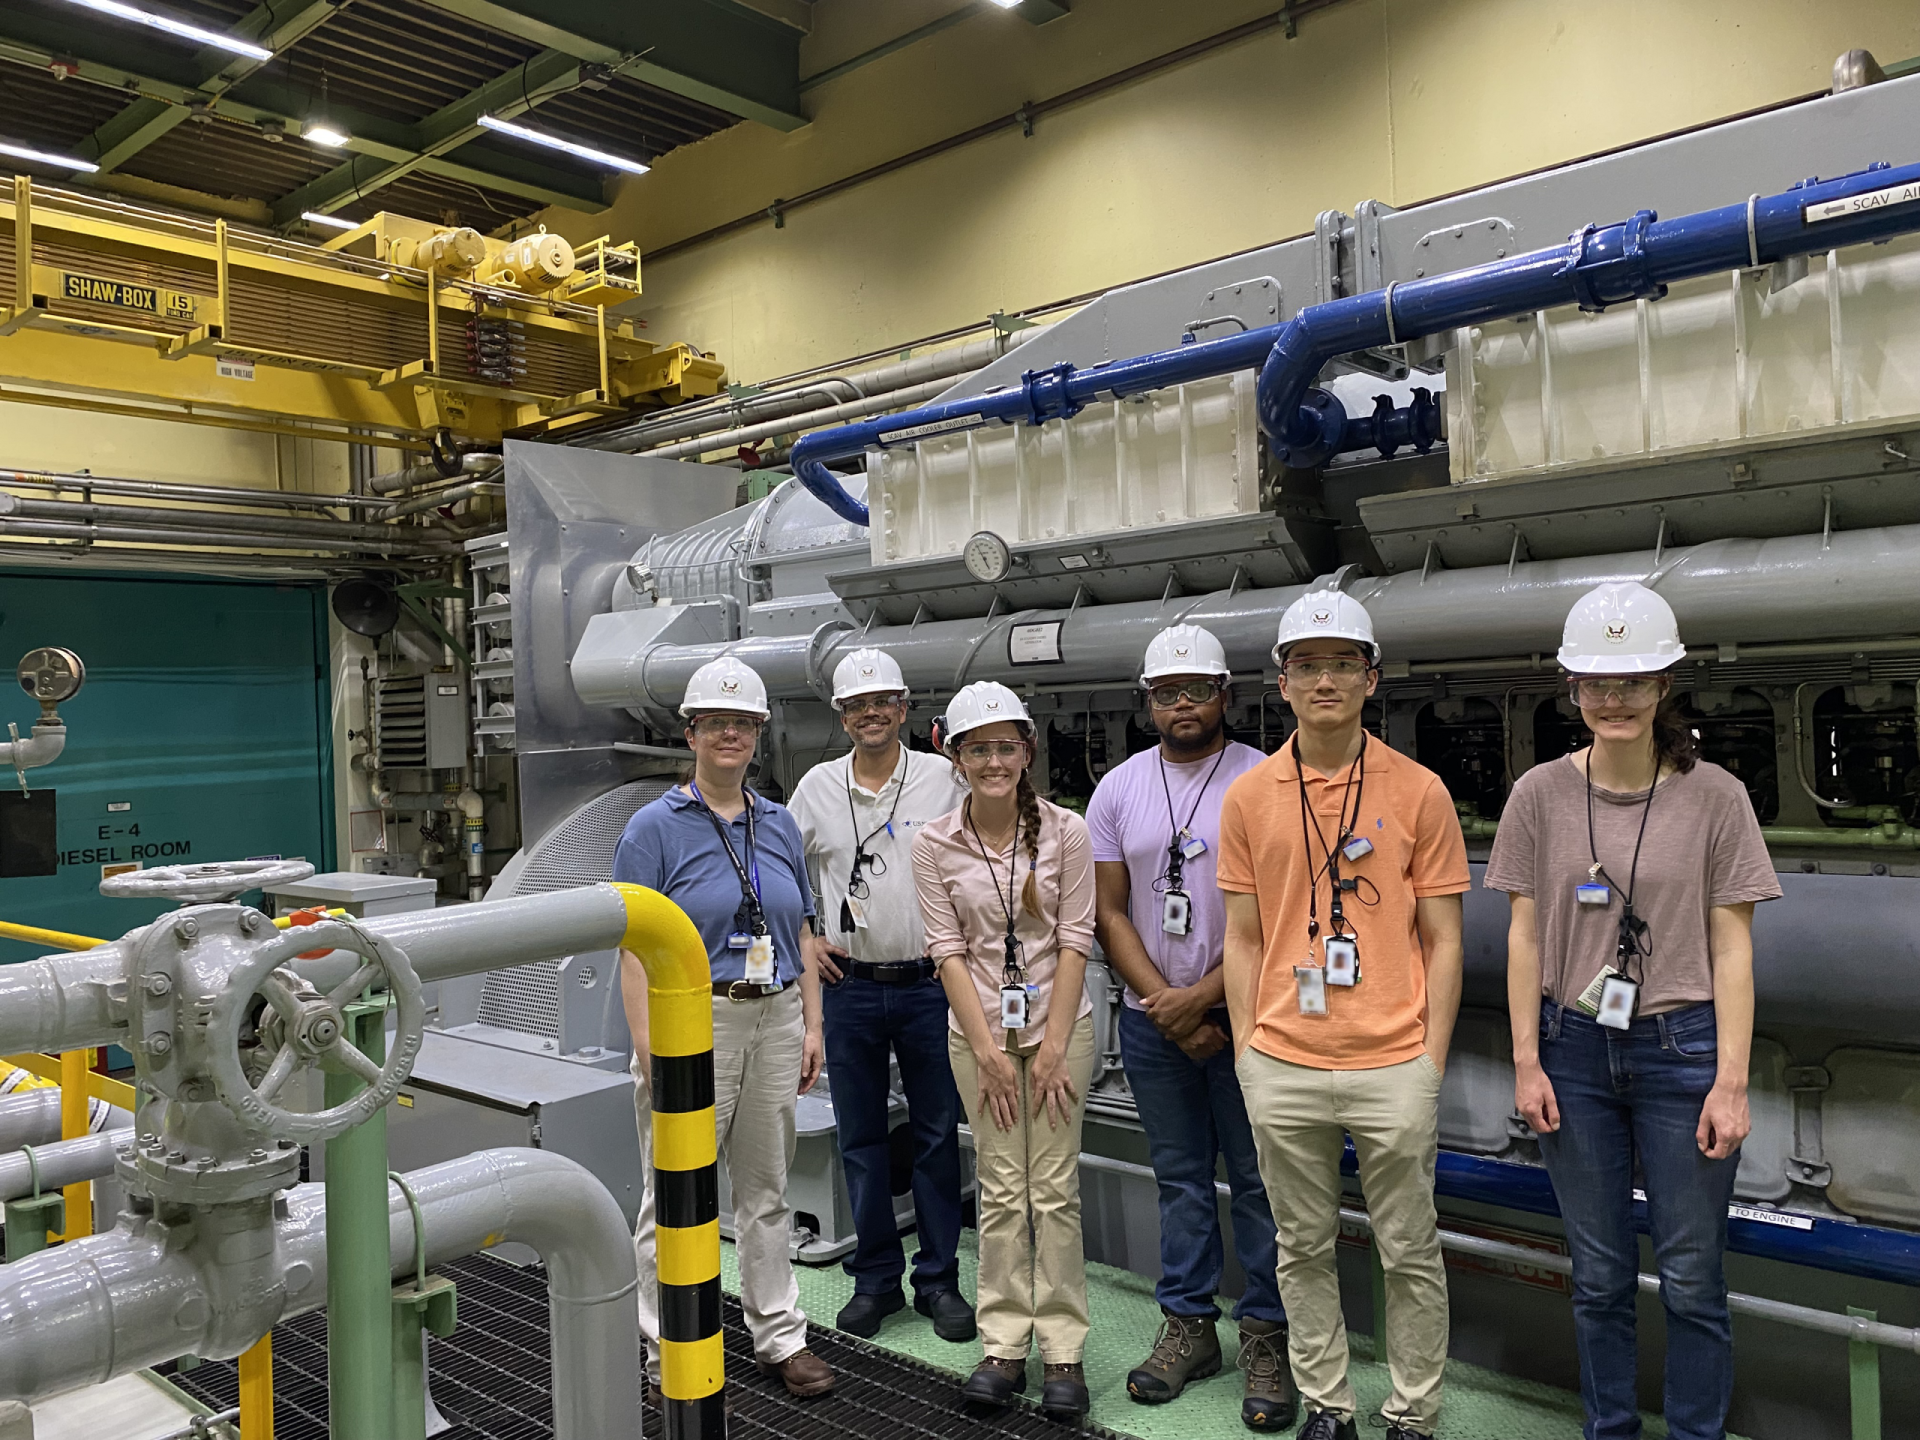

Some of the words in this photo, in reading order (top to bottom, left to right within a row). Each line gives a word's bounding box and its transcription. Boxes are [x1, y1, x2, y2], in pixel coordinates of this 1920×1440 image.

[1853, 193, 1890, 210] SCAV
[1903, 186, 1920, 200] AI
[68, 276, 153, 310] SHAW-BOX
[172, 294, 188, 310] 15
[234, 369, 254, 379] VOLTAGE
[918, 424, 943, 434] COOLER
[945, 418, 969, 429] OUTLET
[57, 847, 122, 867] IESEL
[131, 840, 191, 860] ROOM
[1735, 1208, 1750, 1217] TO
[1753, 1212, 1796, 1225] ENGINE
